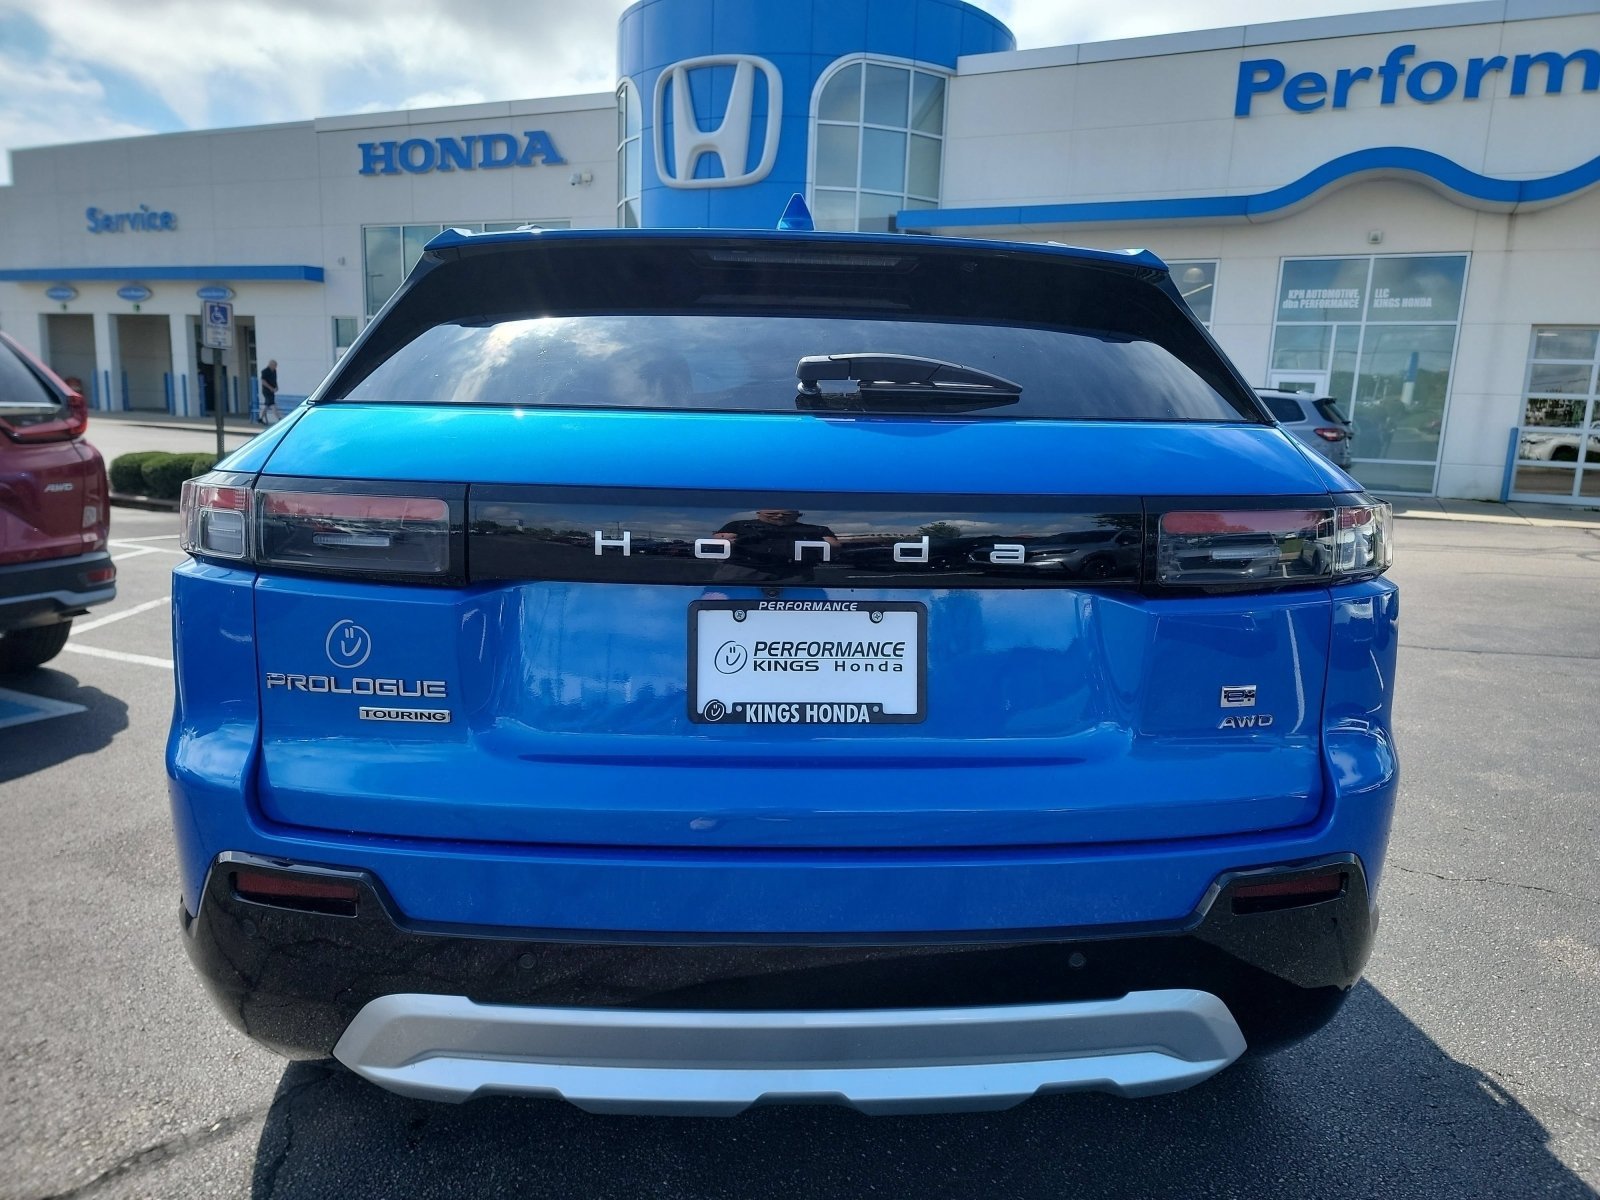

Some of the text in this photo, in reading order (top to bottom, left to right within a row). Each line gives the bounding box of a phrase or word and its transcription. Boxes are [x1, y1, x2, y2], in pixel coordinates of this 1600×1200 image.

[1234, 44, 1600, 118] Perform
[358, 130, 567, 176] HONDA
[86, 204, 177, 233] Service
[1375, 288, 1390, 298] LLC
[1300, 299, 1359, 309] PERFORMANCE
[1373, 298, 1432, 308] KINGS HONDA
[594, 530, 1025, 564] Honda
[758, 602, 858, 611] PERFORMANCE
[753, 641, 905, 657] PERFORMANCE
[753, 660, 903, 672] KINGS Honda
[266, 672, 446, 698] PROLOGUE
[361, 709, 447, 721] TOURING
[746, 704, 870, 723] KINGS HONDA
[1217, 714, 1273, 729] AWD
